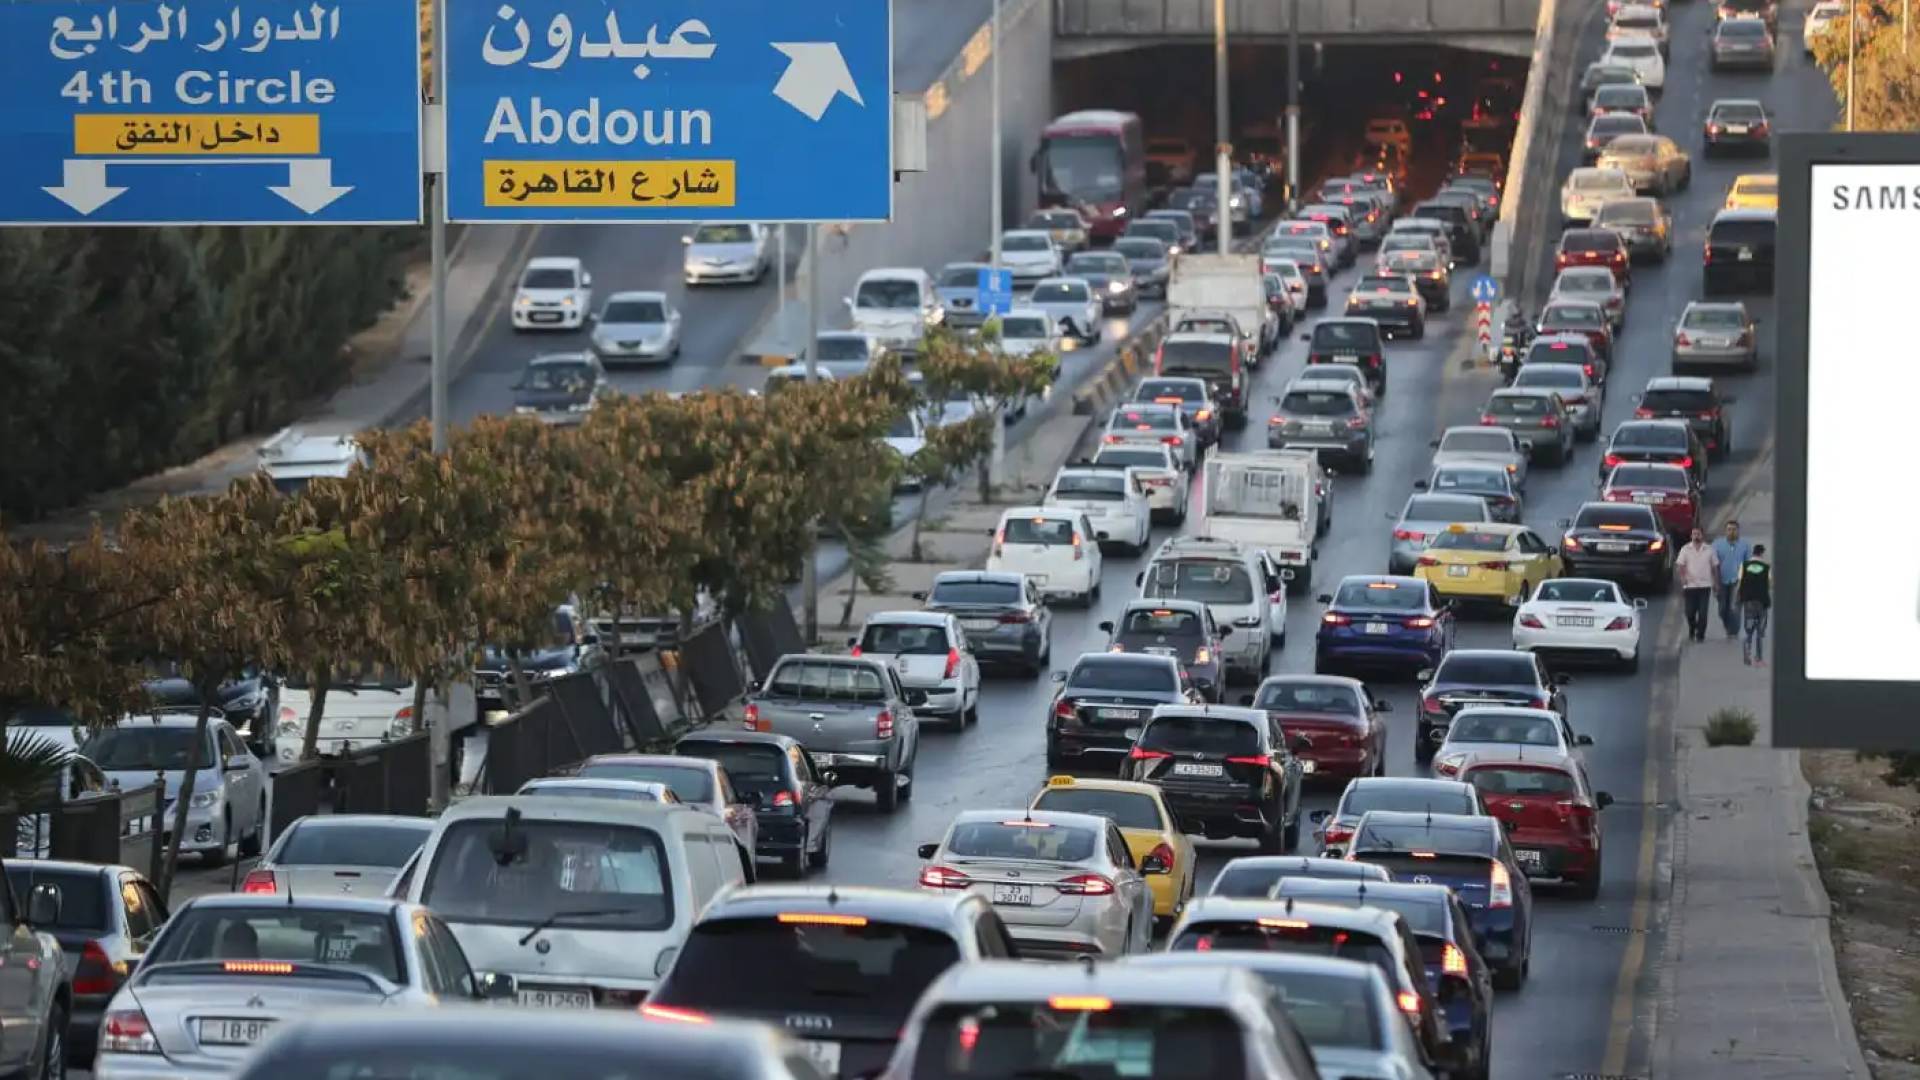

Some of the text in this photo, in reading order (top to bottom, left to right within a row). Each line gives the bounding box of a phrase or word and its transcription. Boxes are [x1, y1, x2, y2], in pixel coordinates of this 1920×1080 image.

[50, 3, 340, 60] الدوار الرابع
[482, 5, 718, 80] عبدون
[61, 70, 335, 104] 4th Circle
[115, 121, 280, 151] داخل النفق
[484, 97, 711, 145] Abdoun
[499, 168, 720, 202] شارع القاهرة
